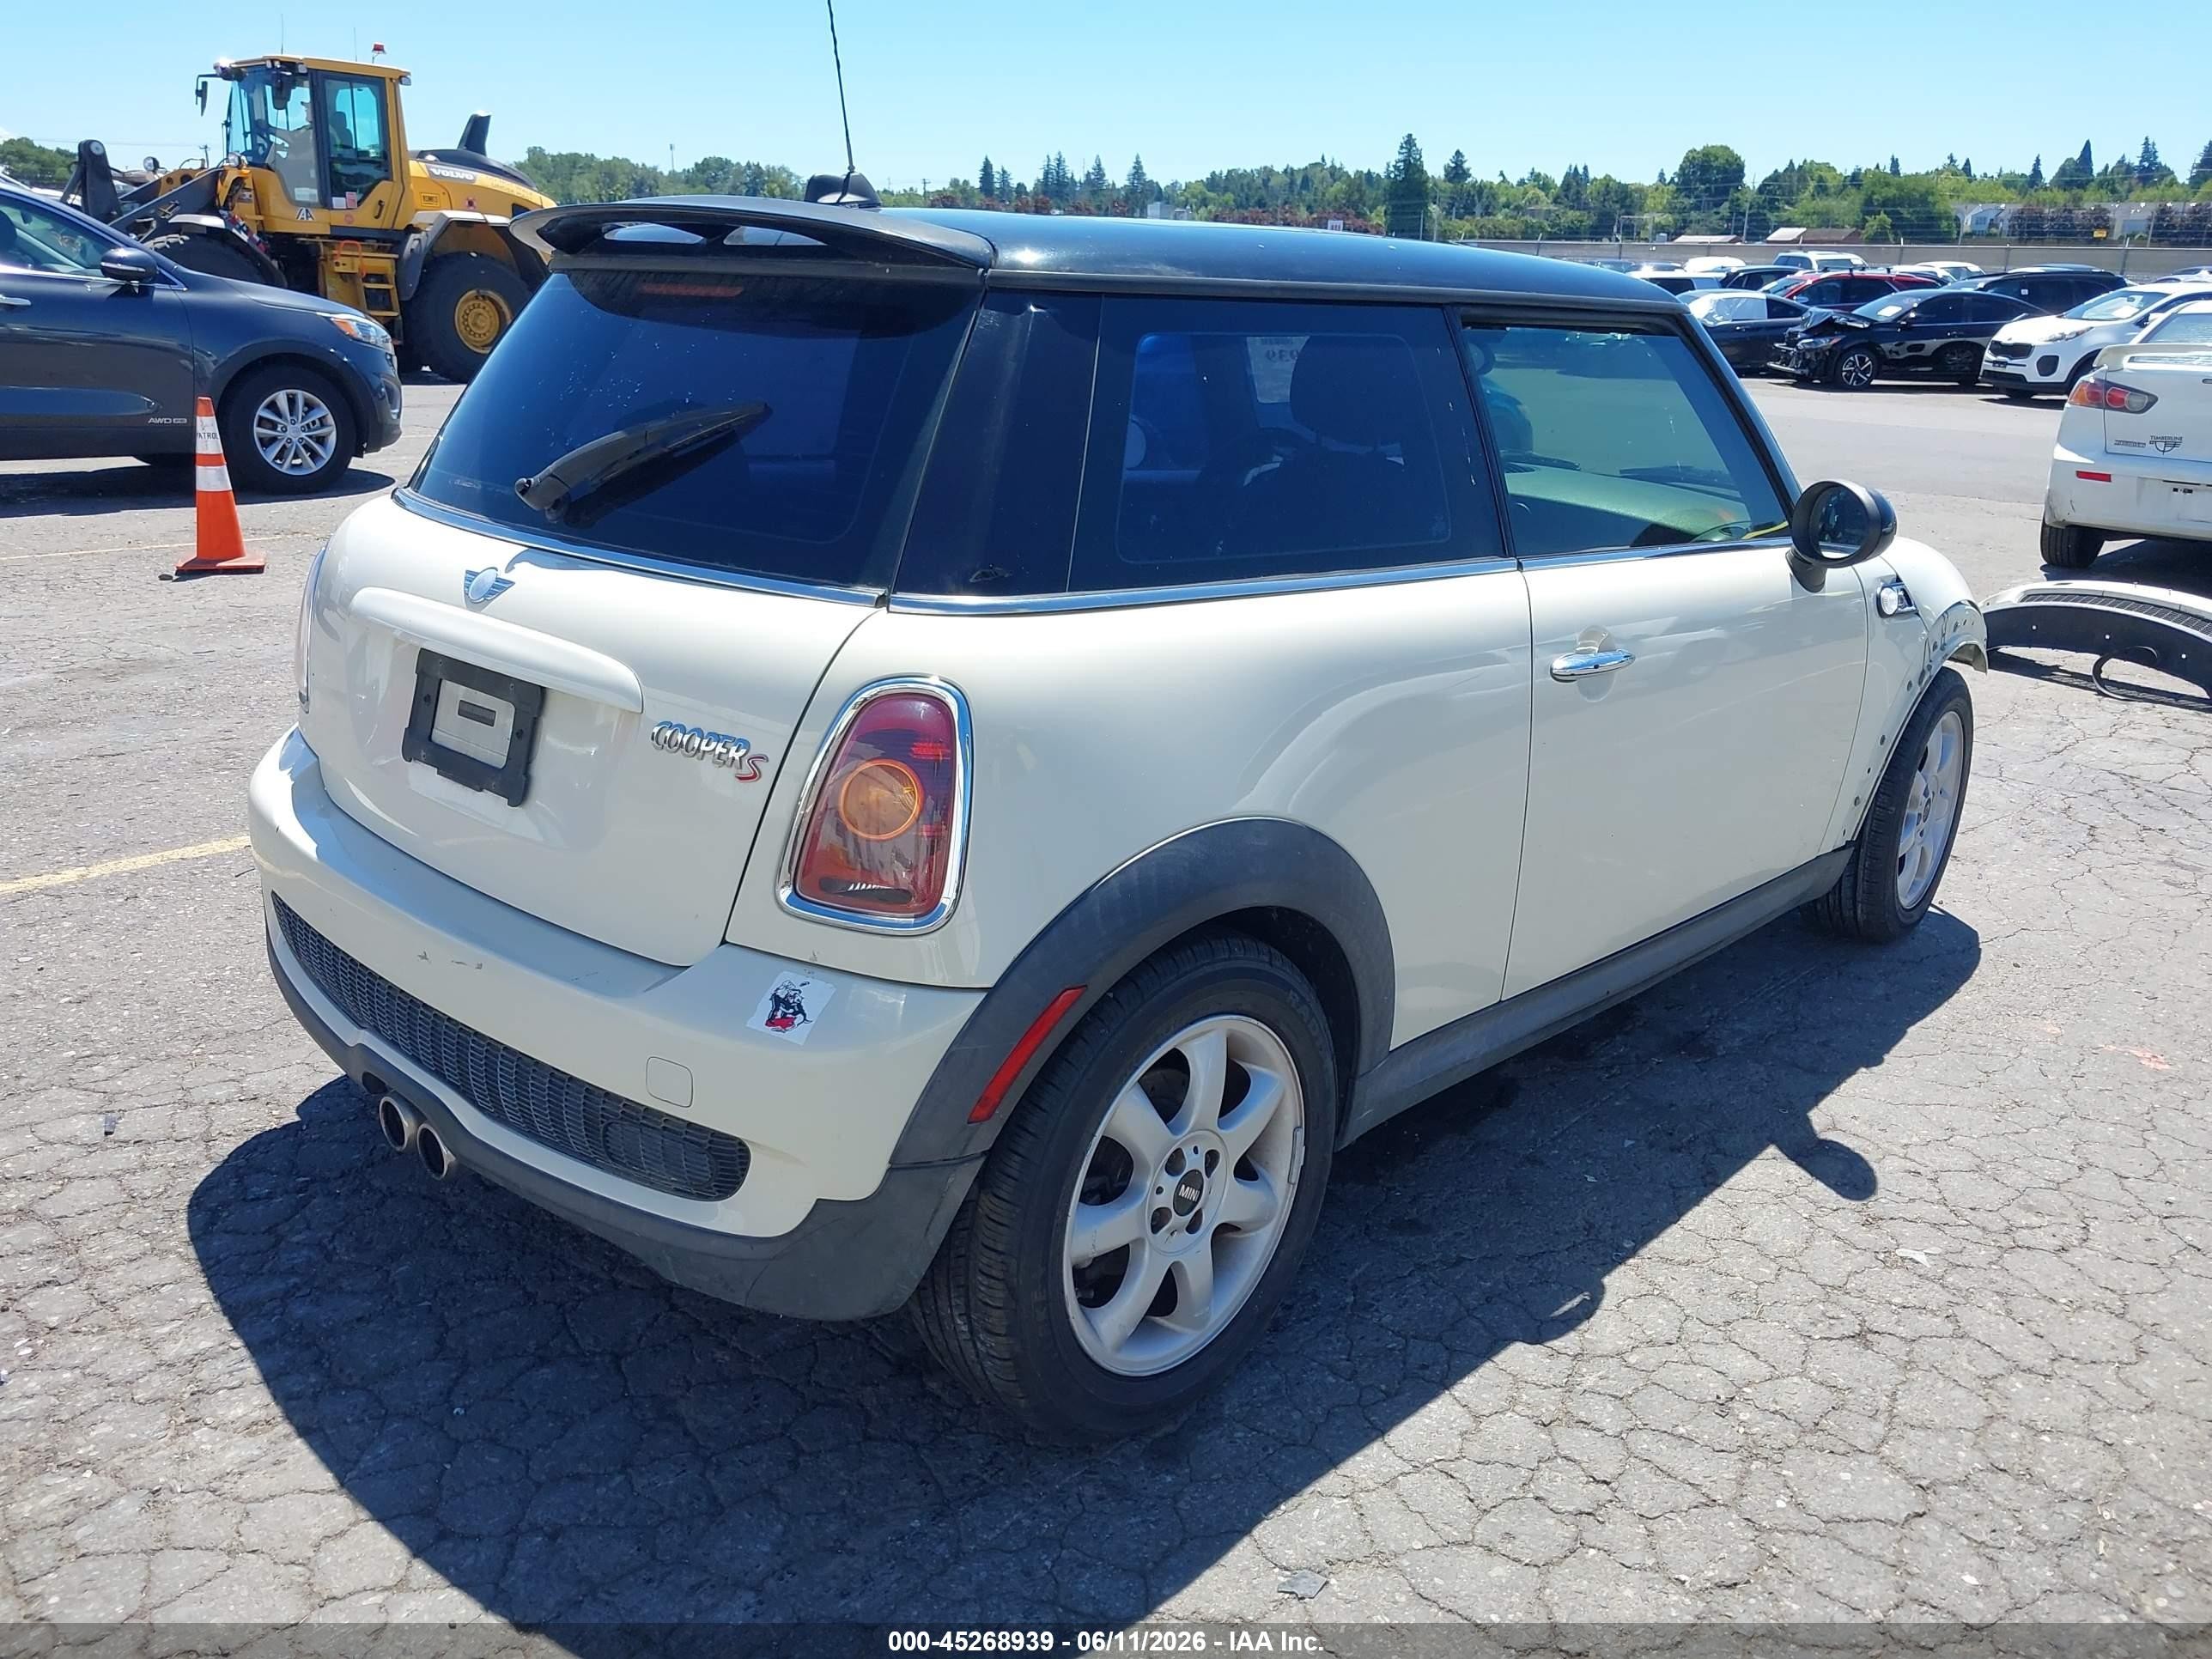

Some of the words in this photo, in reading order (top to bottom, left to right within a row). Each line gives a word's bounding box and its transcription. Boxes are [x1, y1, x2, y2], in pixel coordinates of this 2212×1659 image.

[431, 167, 474, 180] VOLVO
[651, 720, 751, 770] COOPER
[734, 753, 769, 783] S
[1178, 1184, 1200, 1202] MINI
